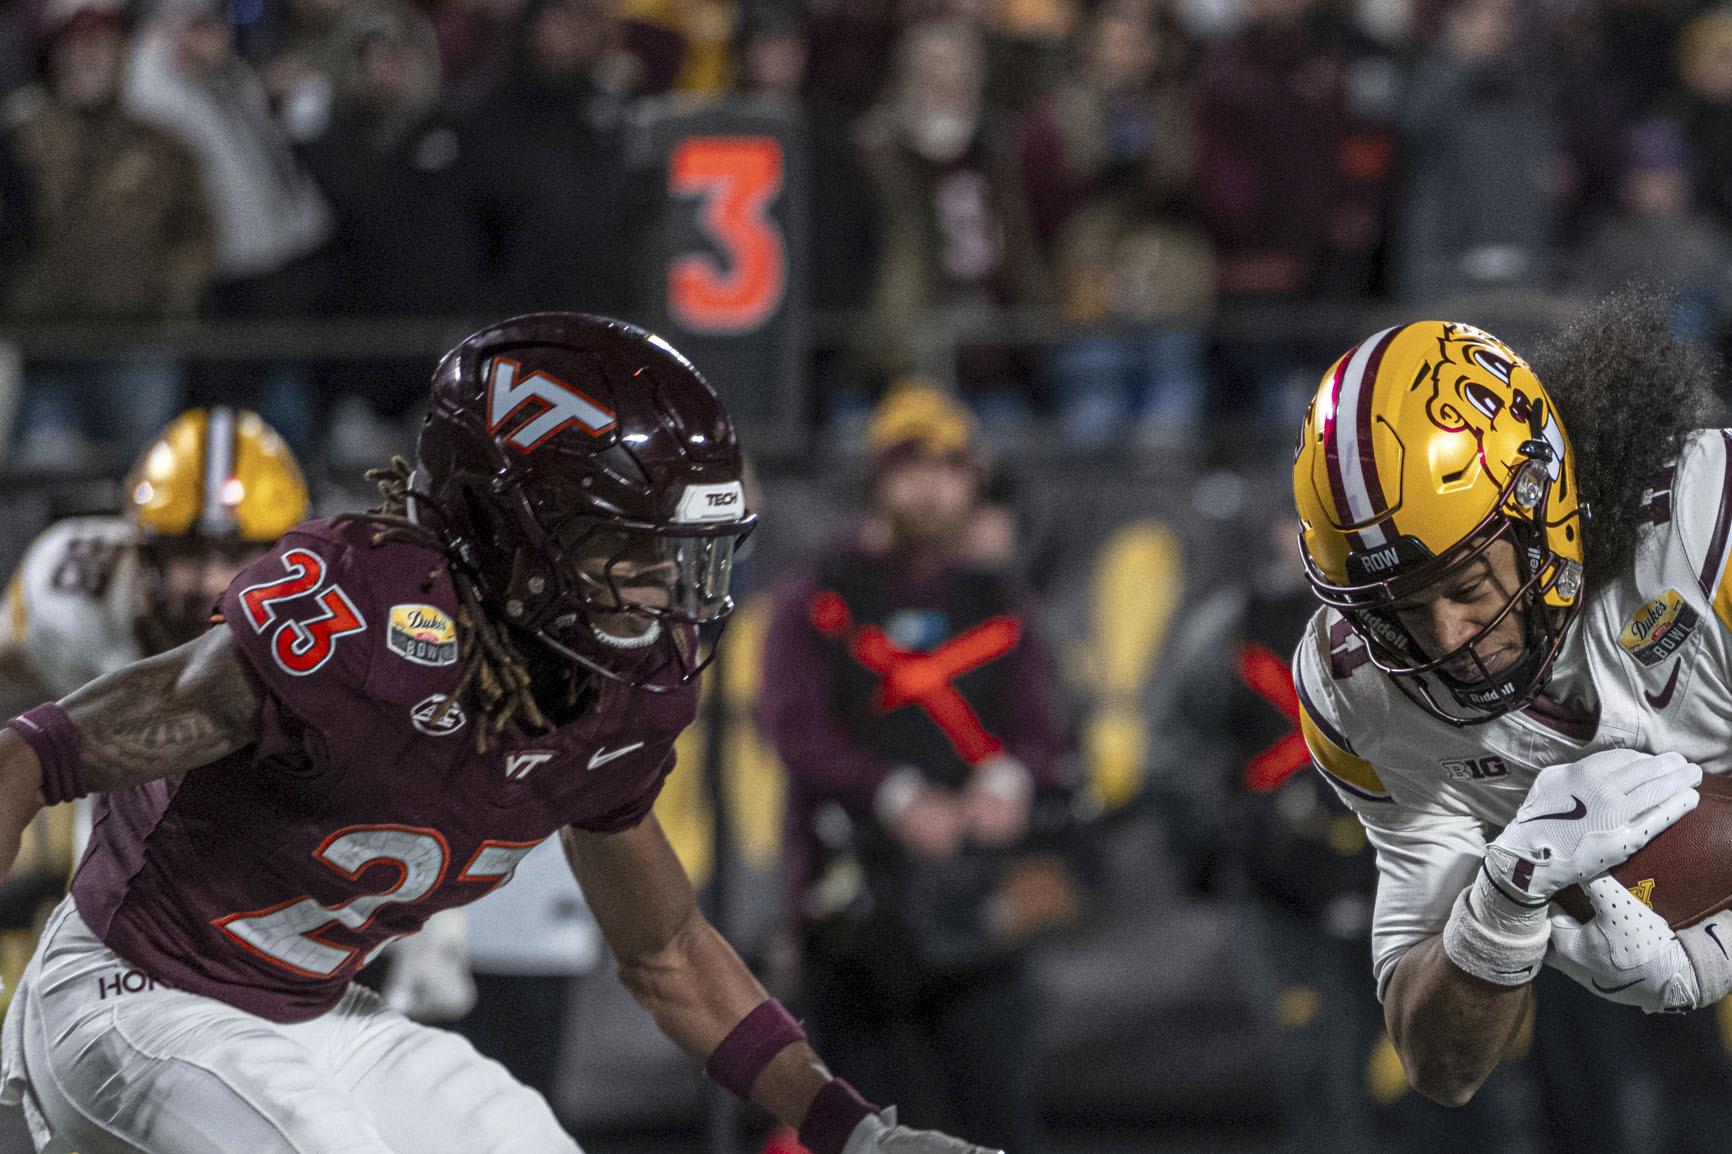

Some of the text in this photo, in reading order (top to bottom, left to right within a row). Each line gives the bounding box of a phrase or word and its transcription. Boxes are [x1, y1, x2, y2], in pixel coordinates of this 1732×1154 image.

[666, 134, 789, 335] 3
[488, 356, 617, 455] VT
[1361, 547, 1400, 574] ROW
[238, 548, 368, 677] 23
[1631, 600, 1667, 641] Duke's
[1652, 622, 1696, 659] BOWL
[506, 753, 554, 779] VT
